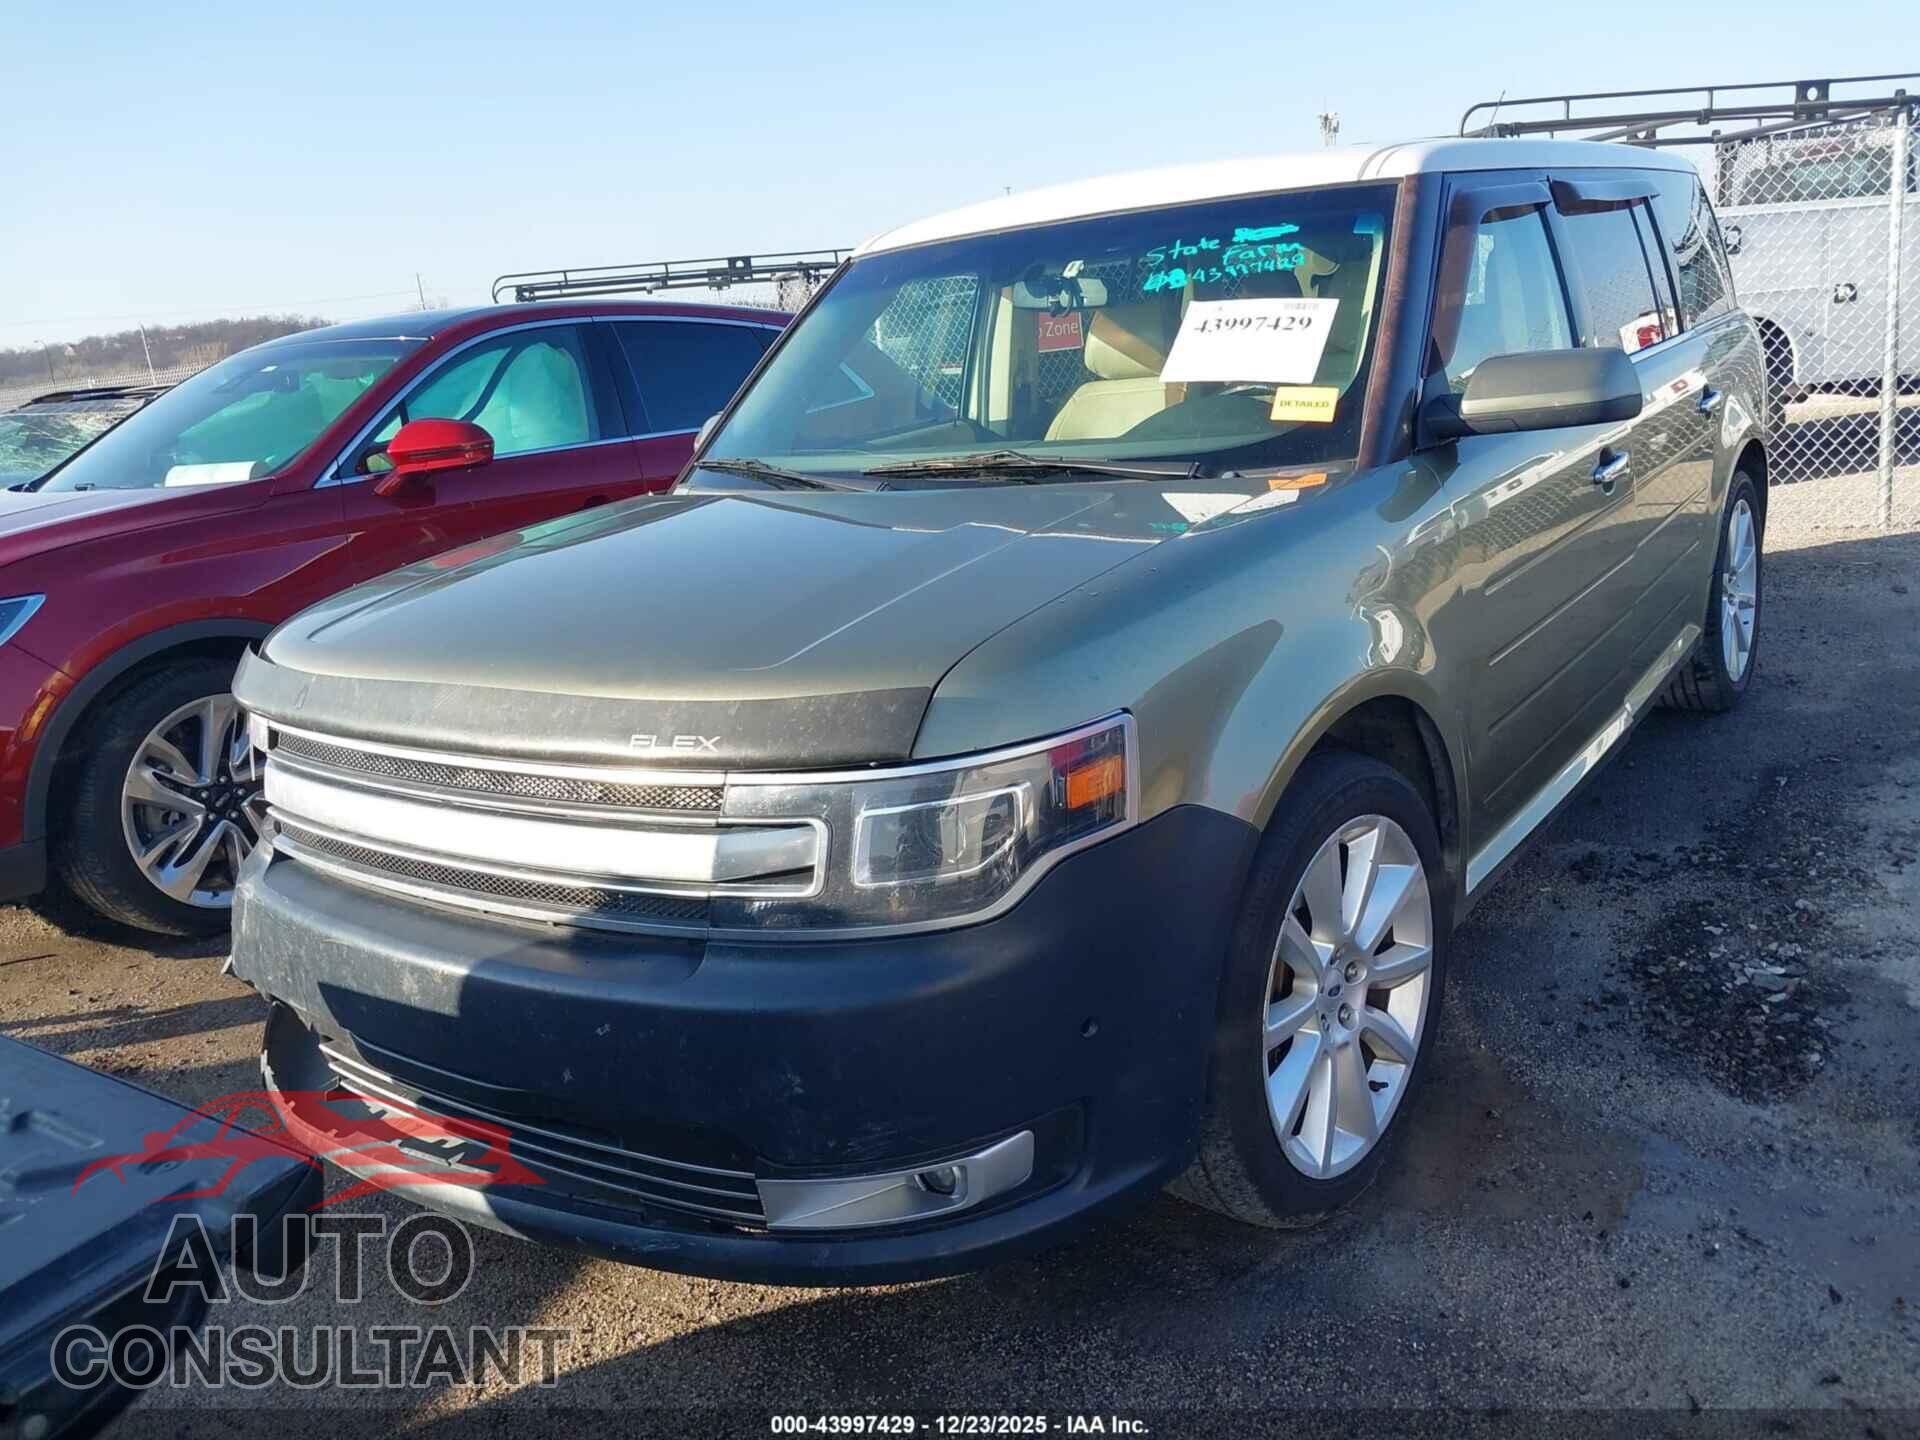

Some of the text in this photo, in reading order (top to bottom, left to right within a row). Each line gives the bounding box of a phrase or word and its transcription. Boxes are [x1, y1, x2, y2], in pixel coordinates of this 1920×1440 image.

[1146, 237, 1304, 267] State Farm
[1045, 321, 1079, 337] Zone
[1193, 316, 1312, 333] 43997429
[1280, 400, 1329, 408] DETAILED
[629, 734, 721, 752] FLEX
